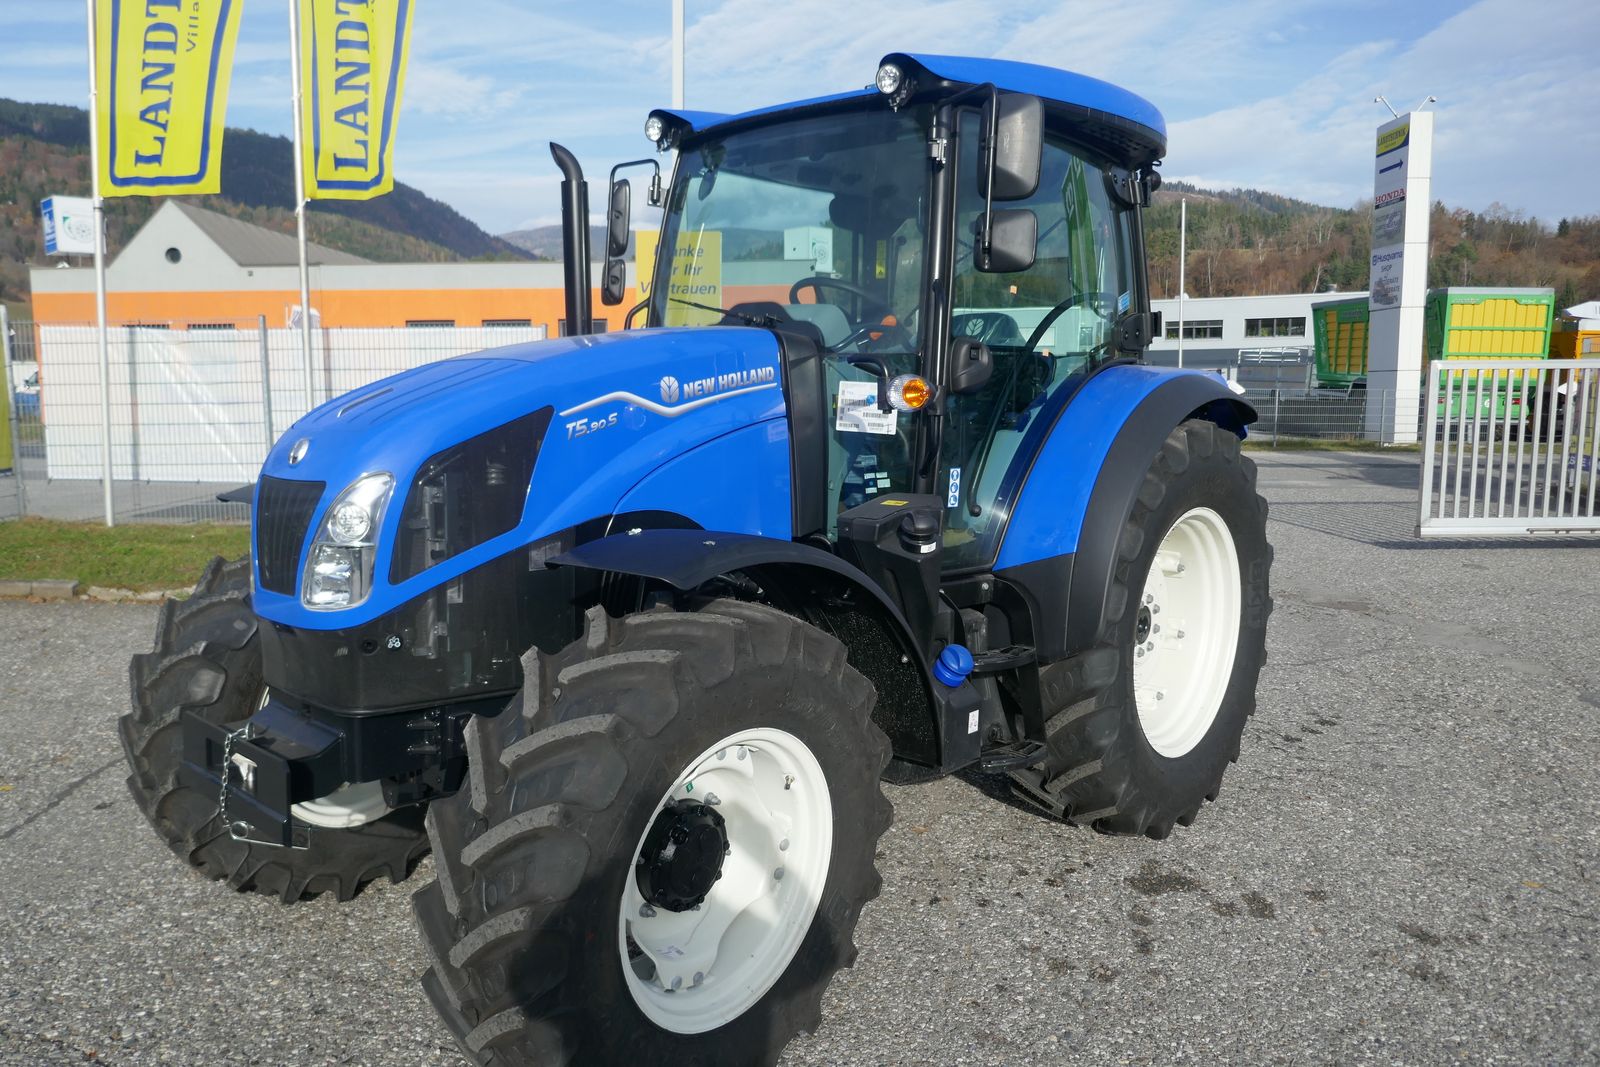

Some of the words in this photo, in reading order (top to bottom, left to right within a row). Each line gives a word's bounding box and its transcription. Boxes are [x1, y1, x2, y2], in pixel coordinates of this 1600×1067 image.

[1375, 188, 1406, 204] HONDA
[684, 263, 703, 276] Ihr
[641, 281, 717, 295] Vtrauen
[683, 376, 715, 399] NEW
[718, 366, 775, 391] HOLLAND
